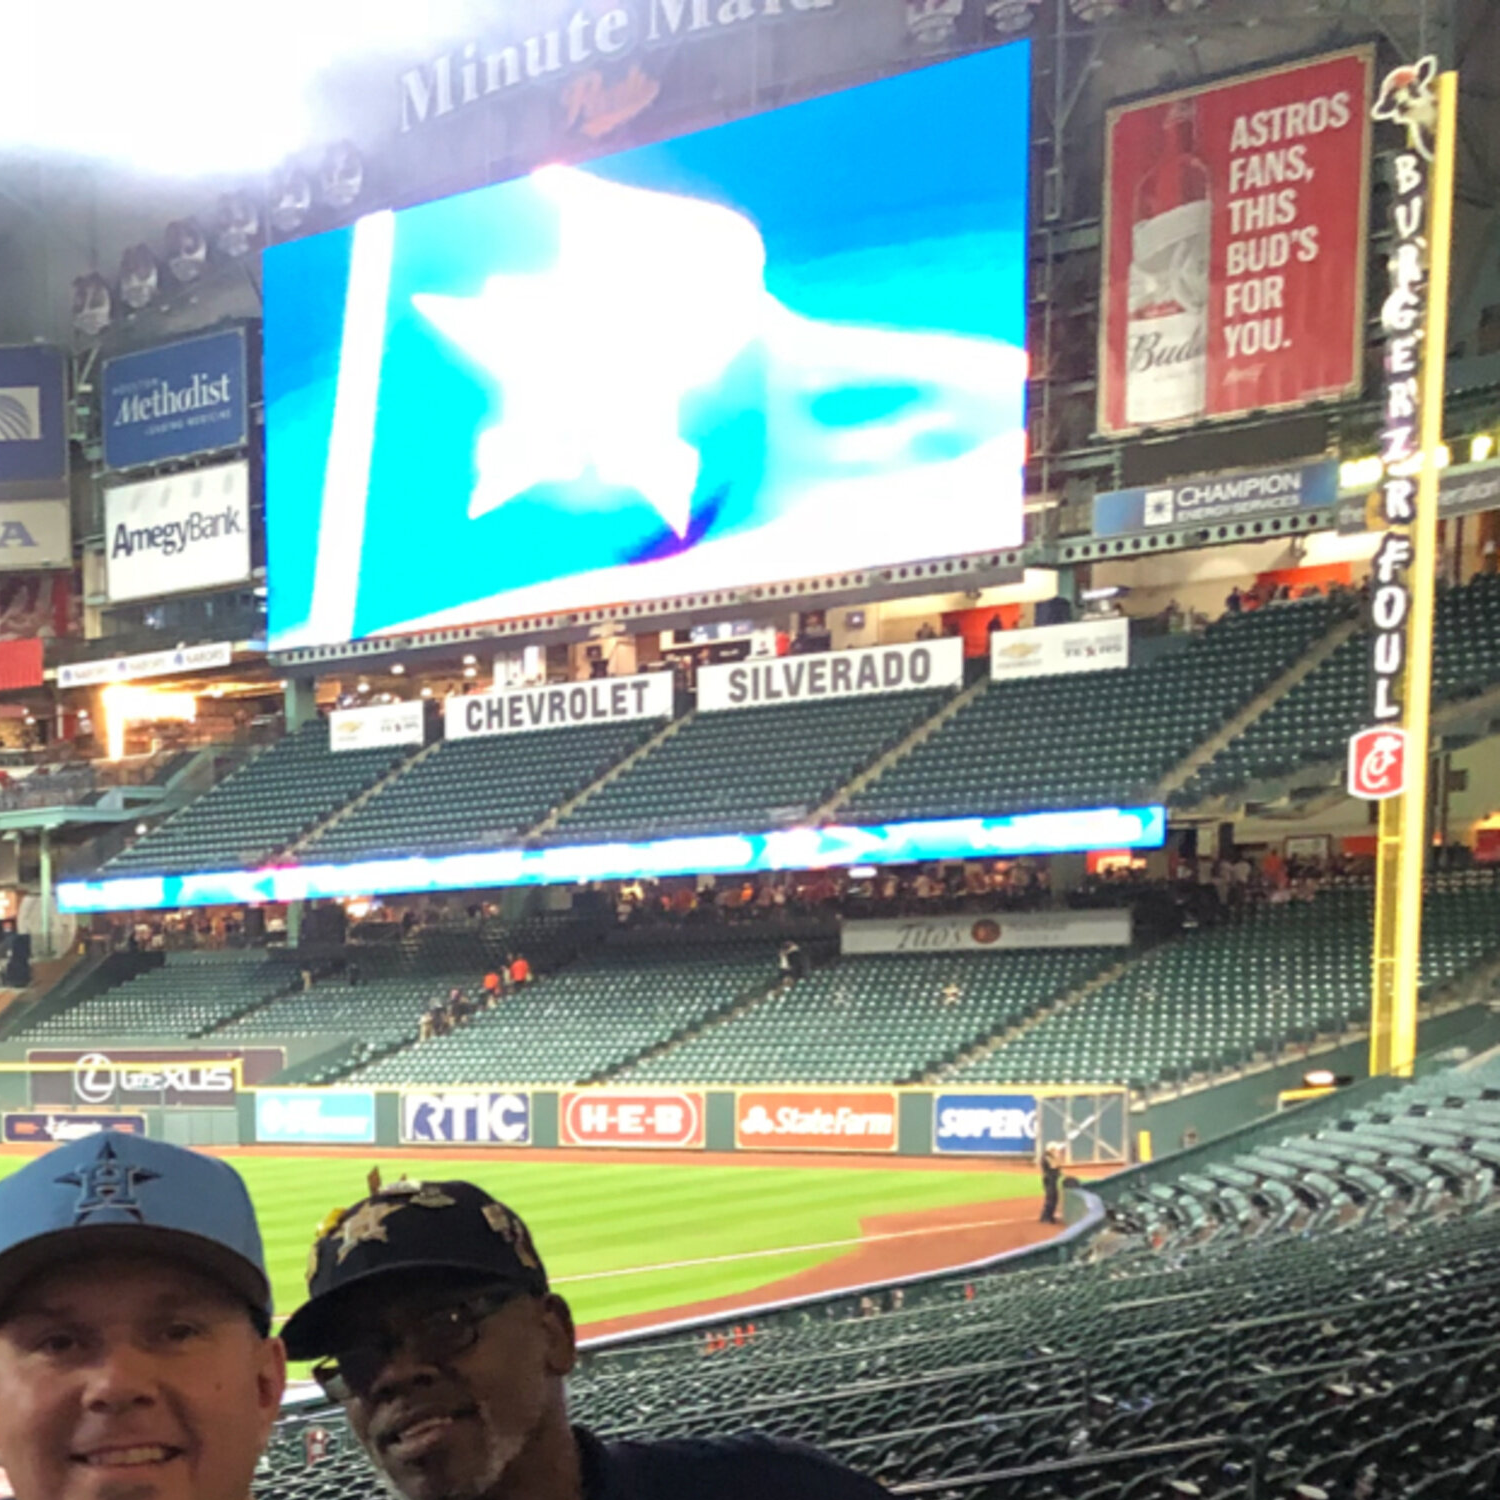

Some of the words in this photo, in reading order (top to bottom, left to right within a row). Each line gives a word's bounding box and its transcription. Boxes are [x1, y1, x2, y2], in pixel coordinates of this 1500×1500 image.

[399, 4, 629, 133] Minute
[647, 0, 835, 41] Ma
[1230, 91, 1350, 152] ASTROS
[1229, 144, 1314, 194] FANS,
[1228, 188, 1297, 235] THIS
[1226, 225, 1319, 277] BUD'S
[1224, 275, 1284, 318] FOR
[1224, 317, 1291, 358] YOU.
[113, 372, 231, 427] Methodist
[1177, 473, 1302, 507] CHAMPION
[1372, 539, 1408, 719] FOUL
[728, 647, 932, 703] SILVERADO
[465, 680, 651, 732] CHEVROLET
[406, 1093, 529, 1141] RTIC
[579, 1102, 685, 1135] H-E-B
